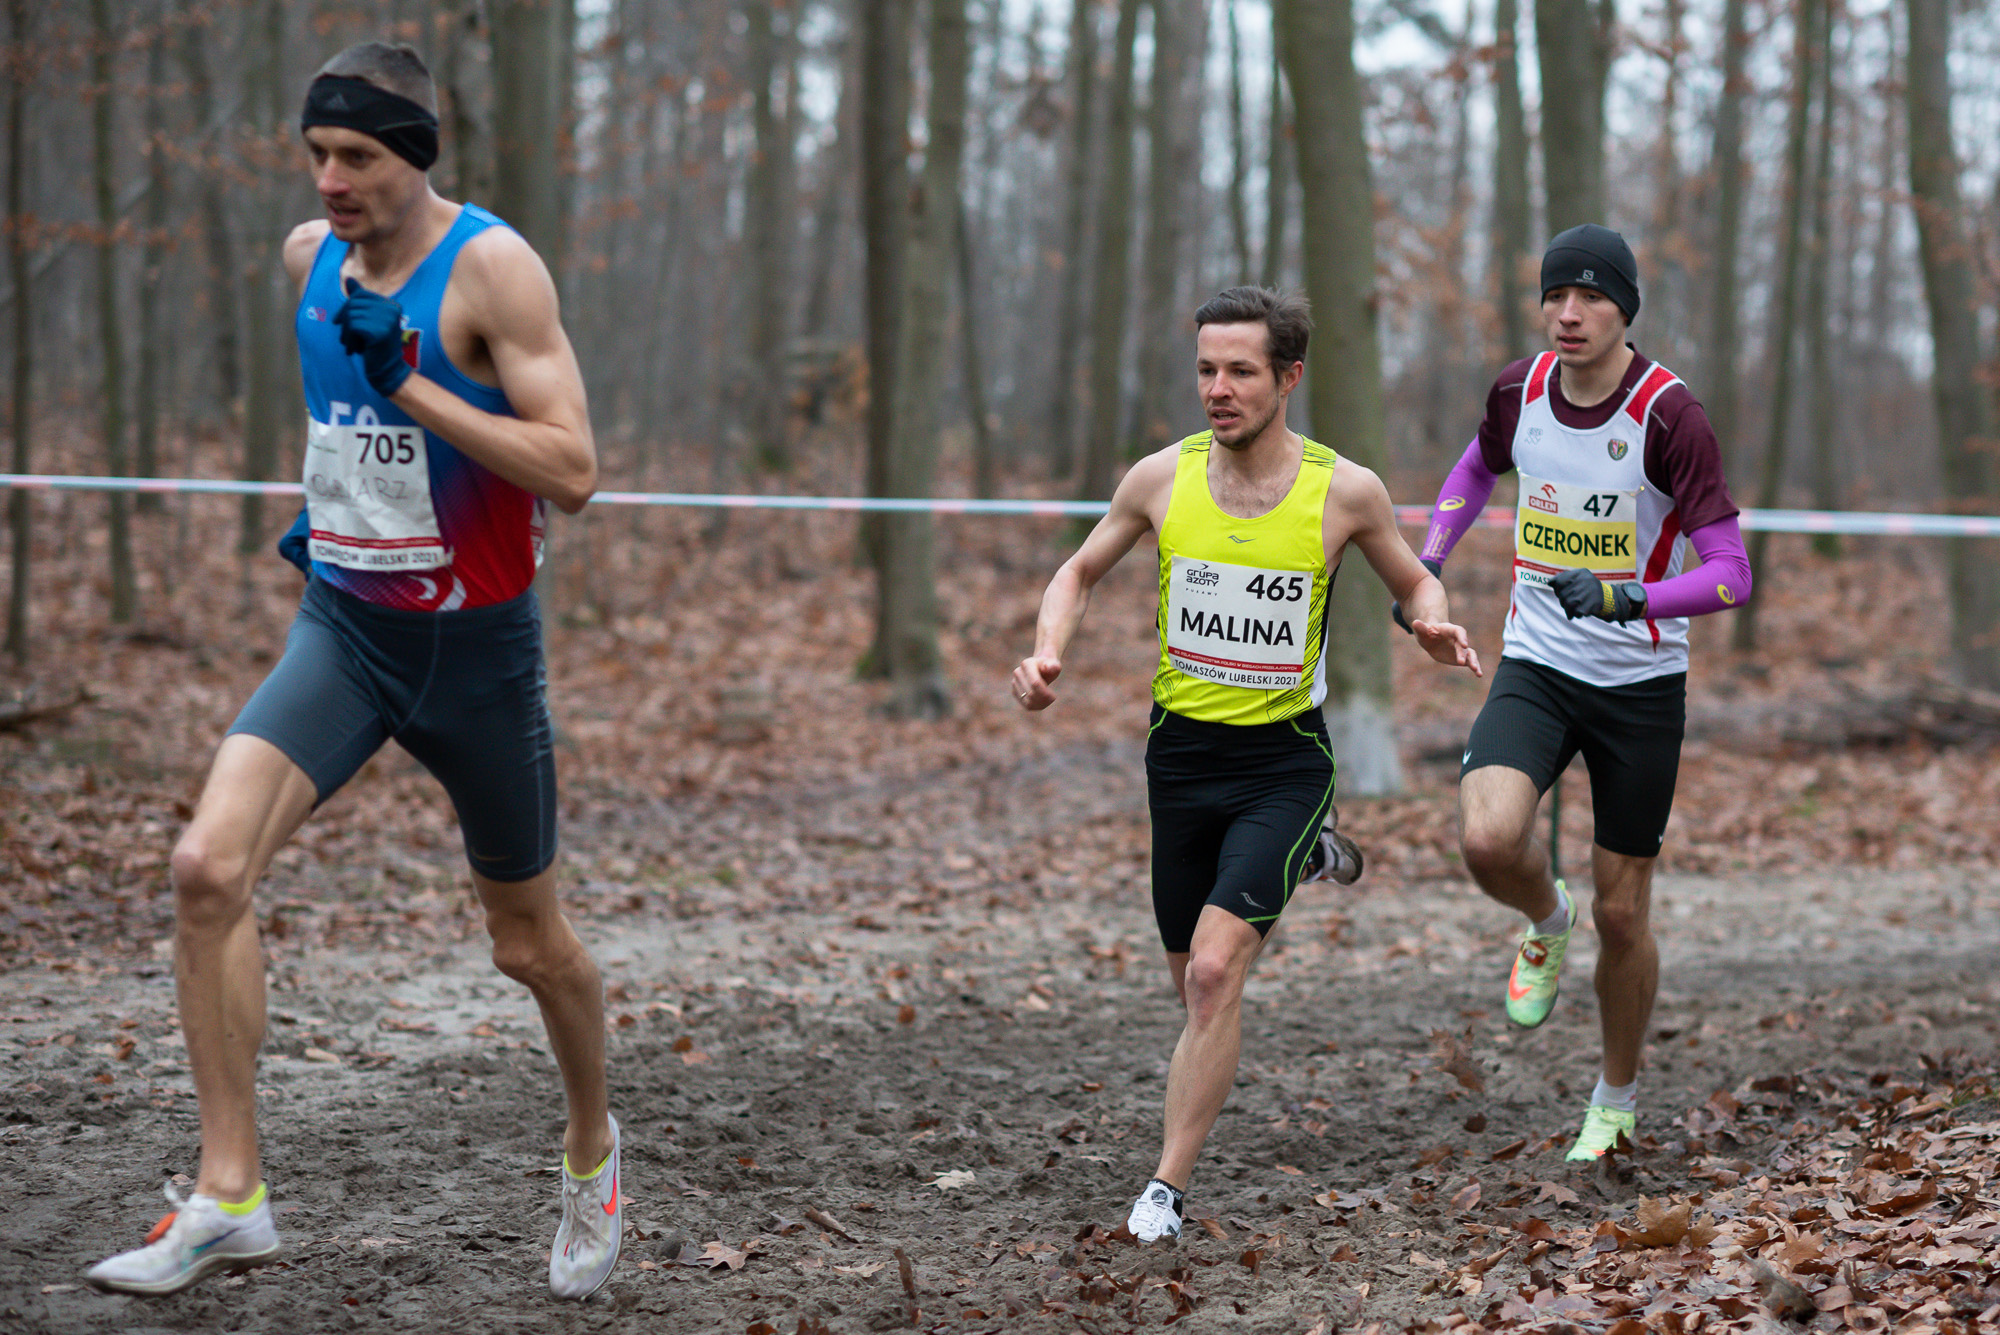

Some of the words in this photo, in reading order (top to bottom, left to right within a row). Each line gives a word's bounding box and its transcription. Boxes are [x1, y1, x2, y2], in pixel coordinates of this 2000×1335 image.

[356, 433, 415, 464] 705
[1530, 498, 1557, 512] ORLEN
[1583, 494, 1619, 517] 47
[1523, 522, 1630, 557] CZERONEK
[1246, 574, 1303, 602] 465
[1180, 606, 1294, 647] MALINA
[1175, 659, 1226, 680] TOMASZÓW
[1229, 673, 1272, 685] LUBELSKI
[1274, 676, 1297, 685] 2021
